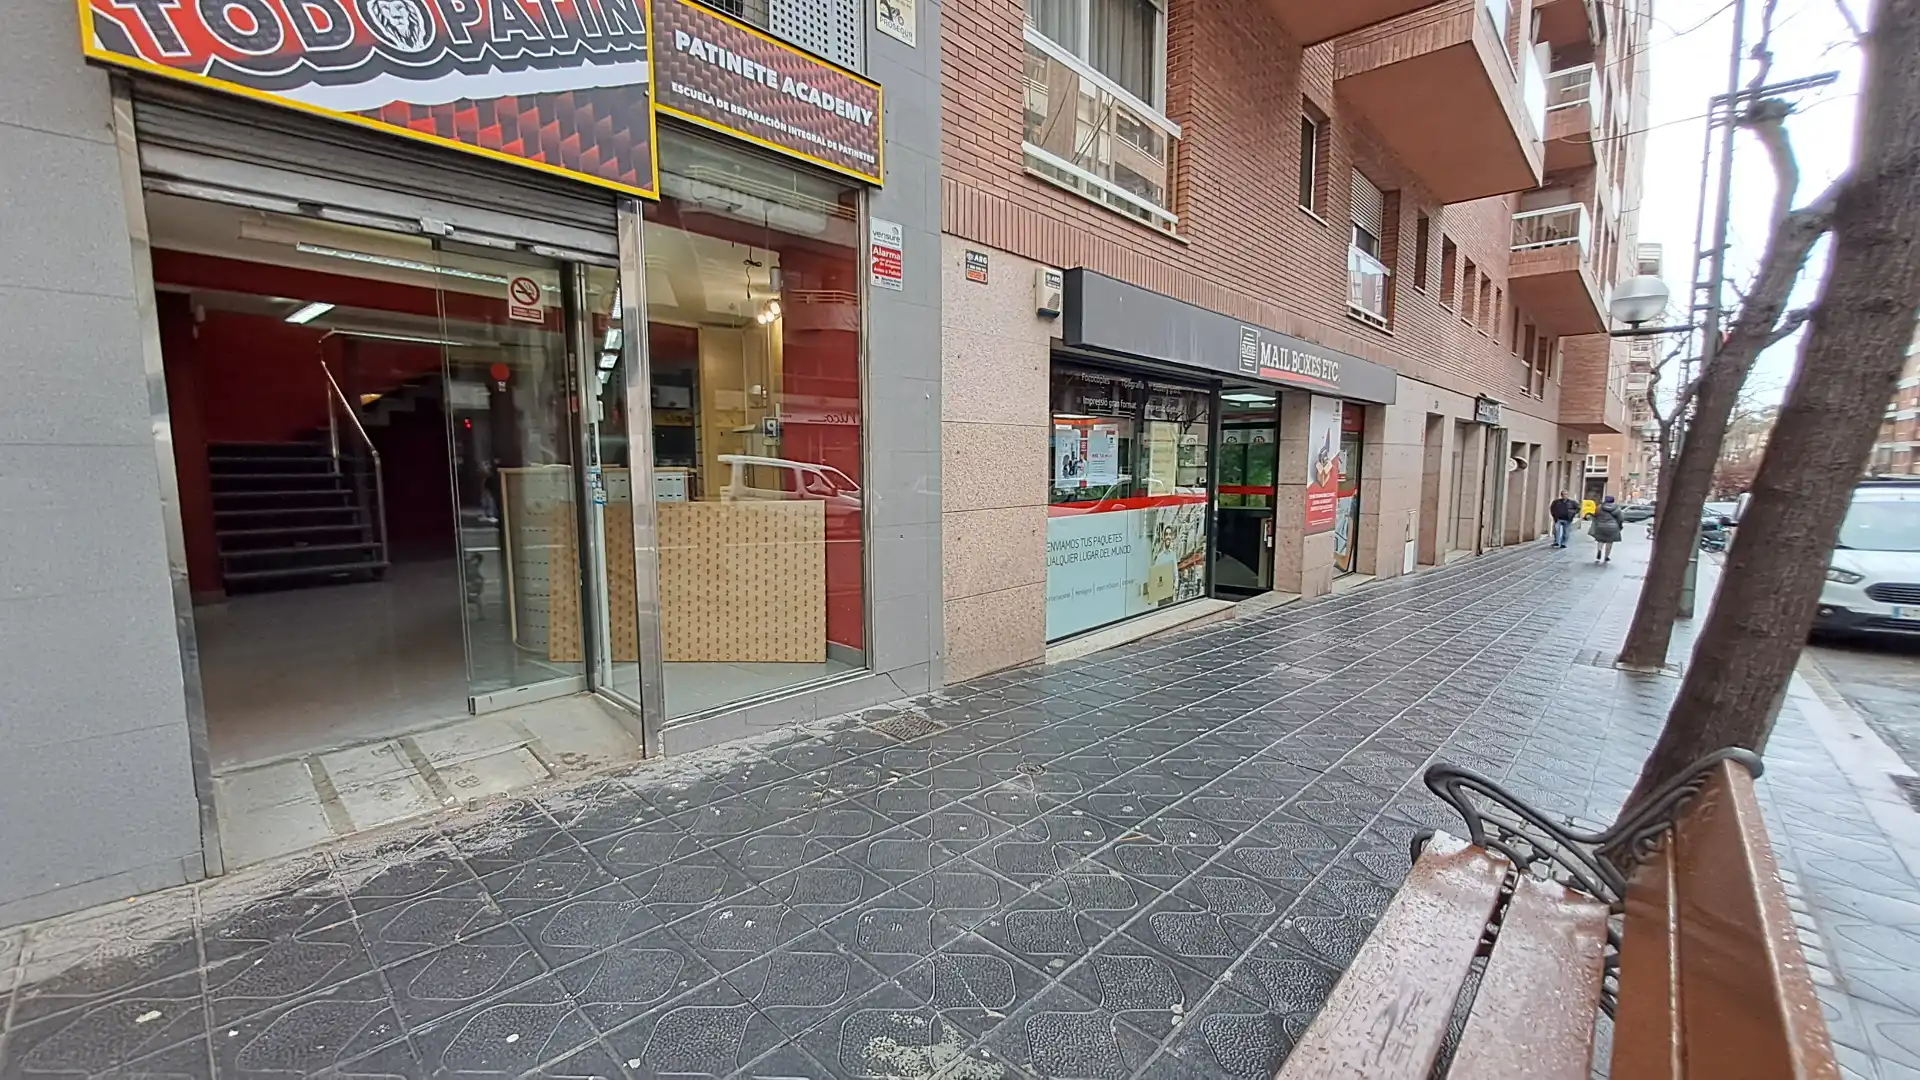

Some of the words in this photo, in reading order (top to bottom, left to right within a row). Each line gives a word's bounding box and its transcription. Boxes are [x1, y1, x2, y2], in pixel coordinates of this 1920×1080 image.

[880, 17, 912, 41] PROSEGUR
[674, 29, 778, 89] PATINETE
[782, 77, 873, 127] ACADEMY
[672, 82, 715, 106] ESCUELA
[716, 98, 730, 112] DE
[731, 103, 787, 132] REPARACIÓN
[788, 125, 826, 146] INTEGRAL
[827, 139, 838, 150] DE
[839, 141, 875, 164] PATINETES
[873, 247, 901, 260] Alarma
[974, 254, 988, 264] ARG
[1260, 342, 1291, 370] MAIL
[1292, 351, 1321, 377] BOXES
[1082, 396, 1108, 409] Impressió
[1109, 400, 1120, 409] gran
[1120, 400, 1137, 410] format
[1047, 538, 1080, 553] ENVIAMOS
[1081, 536, 1093, 547] TUS
[1093, 533, 1123, 547] PAQUETES
[1046, 553, 1079, 567] UALQUIER
[1079, 549, 1100, 562] LUGAR
[1100, 547, 1110, 559] DEL
[1111, 544, 1132, 556] MUNDO
